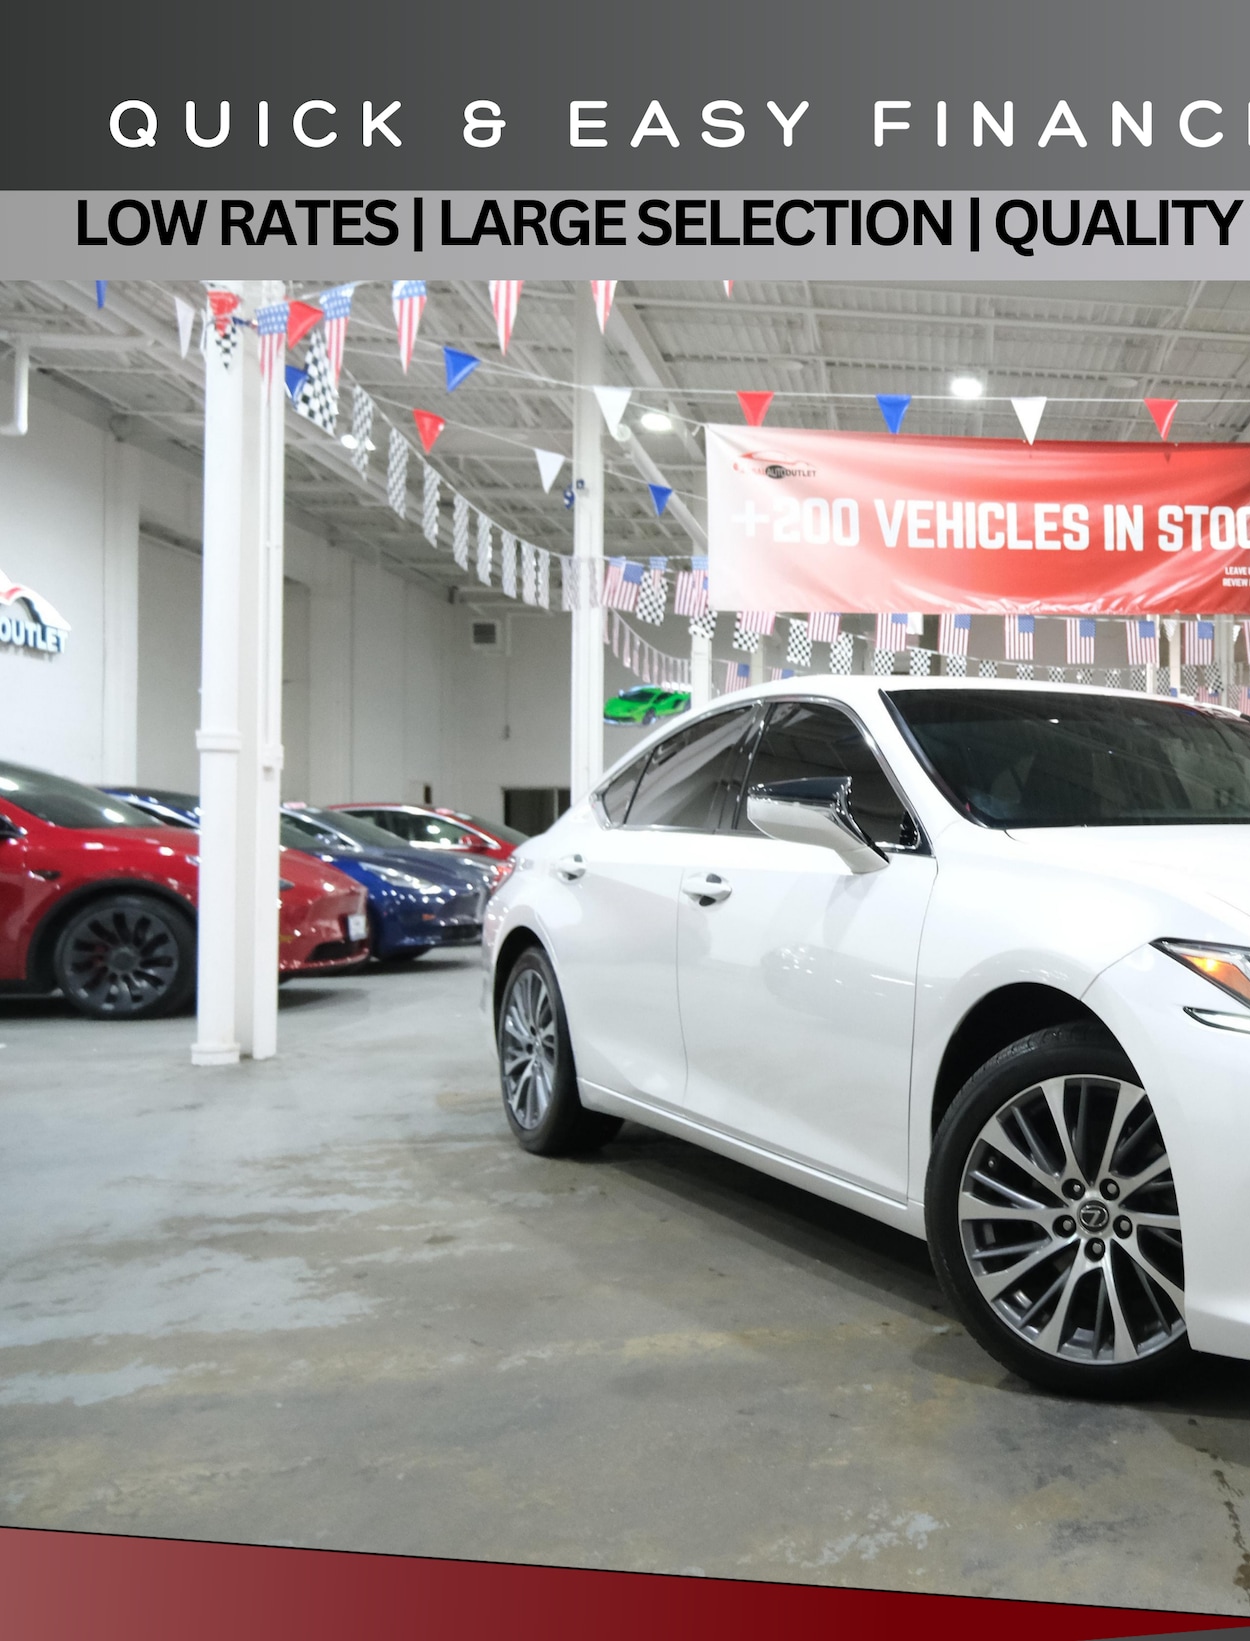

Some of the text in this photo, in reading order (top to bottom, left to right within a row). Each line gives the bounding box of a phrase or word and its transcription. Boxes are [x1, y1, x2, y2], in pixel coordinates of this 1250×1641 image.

[731, 497, 860, 547] +200
[873, 499, 1090, 551] VEHICLES
[1103, 504, 1145, 552] IN
[1224, 565, 1247, 576] LEAVE
[0, 615, 68, 654] OUTLET
